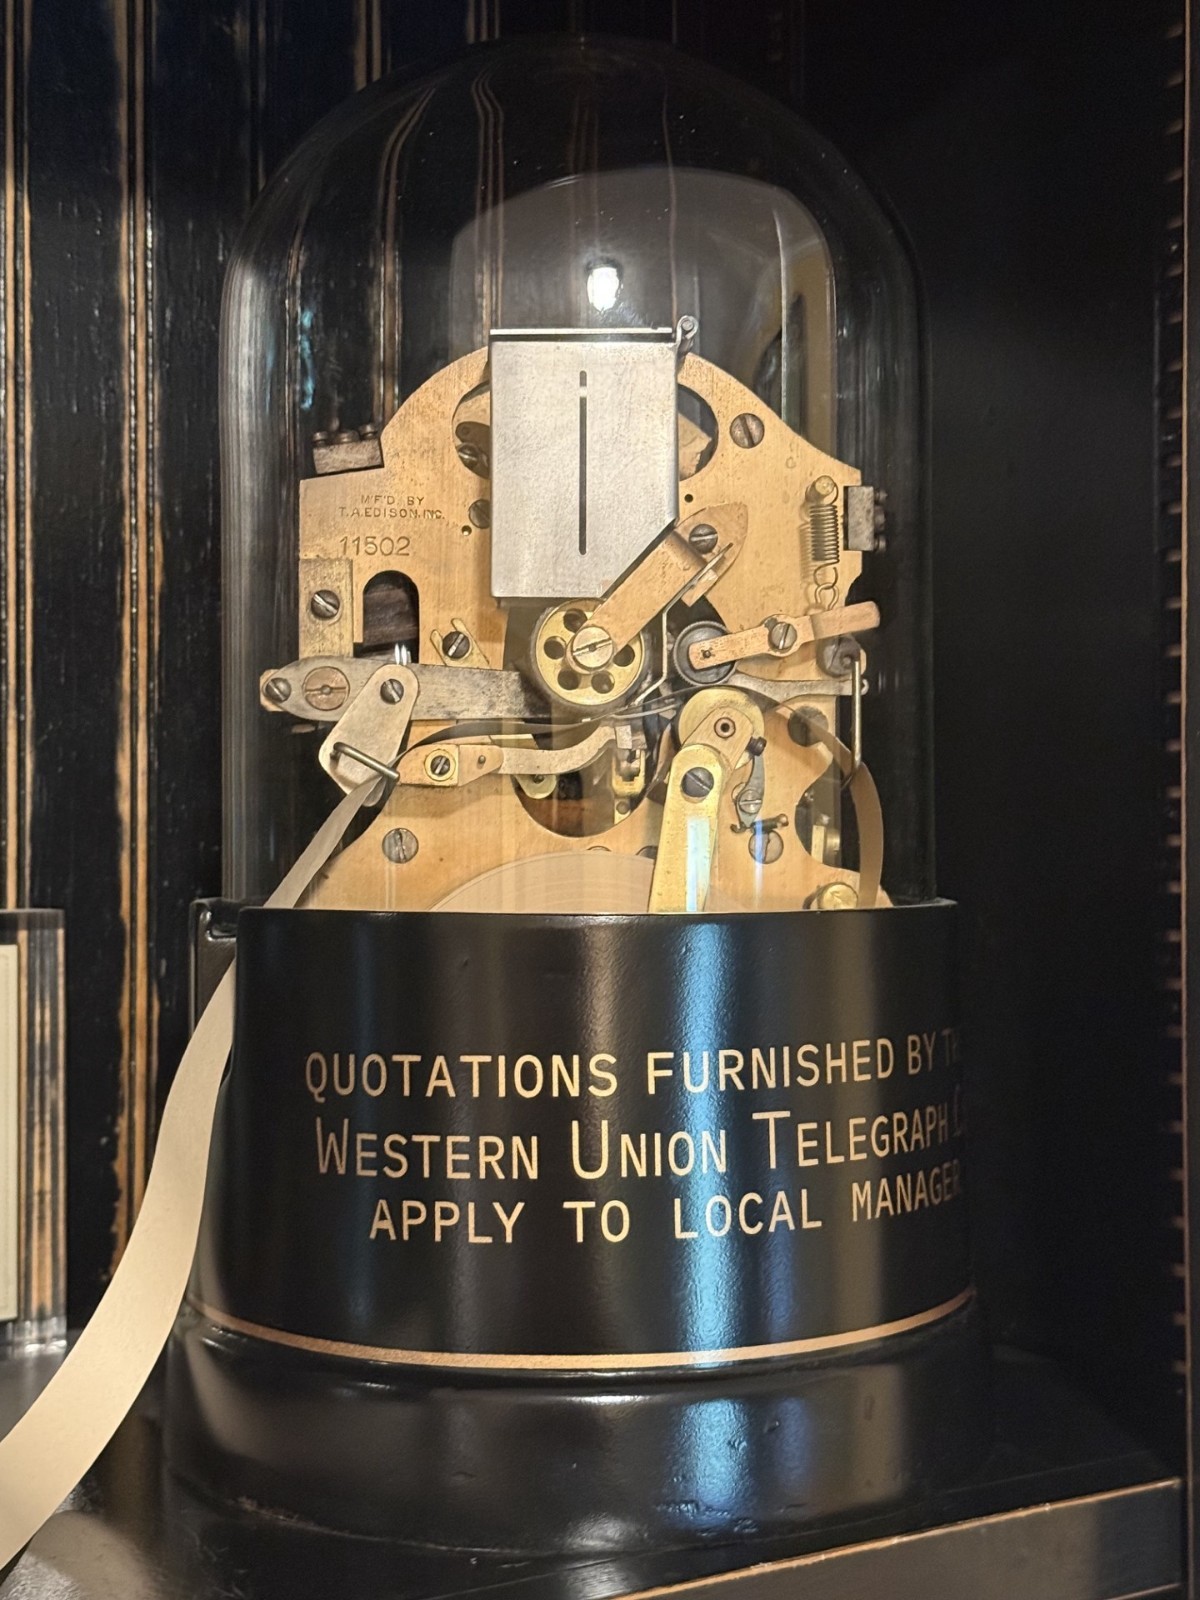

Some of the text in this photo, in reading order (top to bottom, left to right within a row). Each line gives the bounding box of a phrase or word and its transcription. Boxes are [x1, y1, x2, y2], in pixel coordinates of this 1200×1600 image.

[406, 495, 425, 506] BY
[339, 535, 411, 557] 11502
[305, 1052, 618, 1102] QUOTATIONS
[647, 1038, 895, 1095] FURNISHED
[907, 1032, 936, 1076] BY
[369, 1199, 525, 1244] APPLY
[563, 1199, 631, 1243] TO
[673, 1188, 823, 1239] LOCAL
